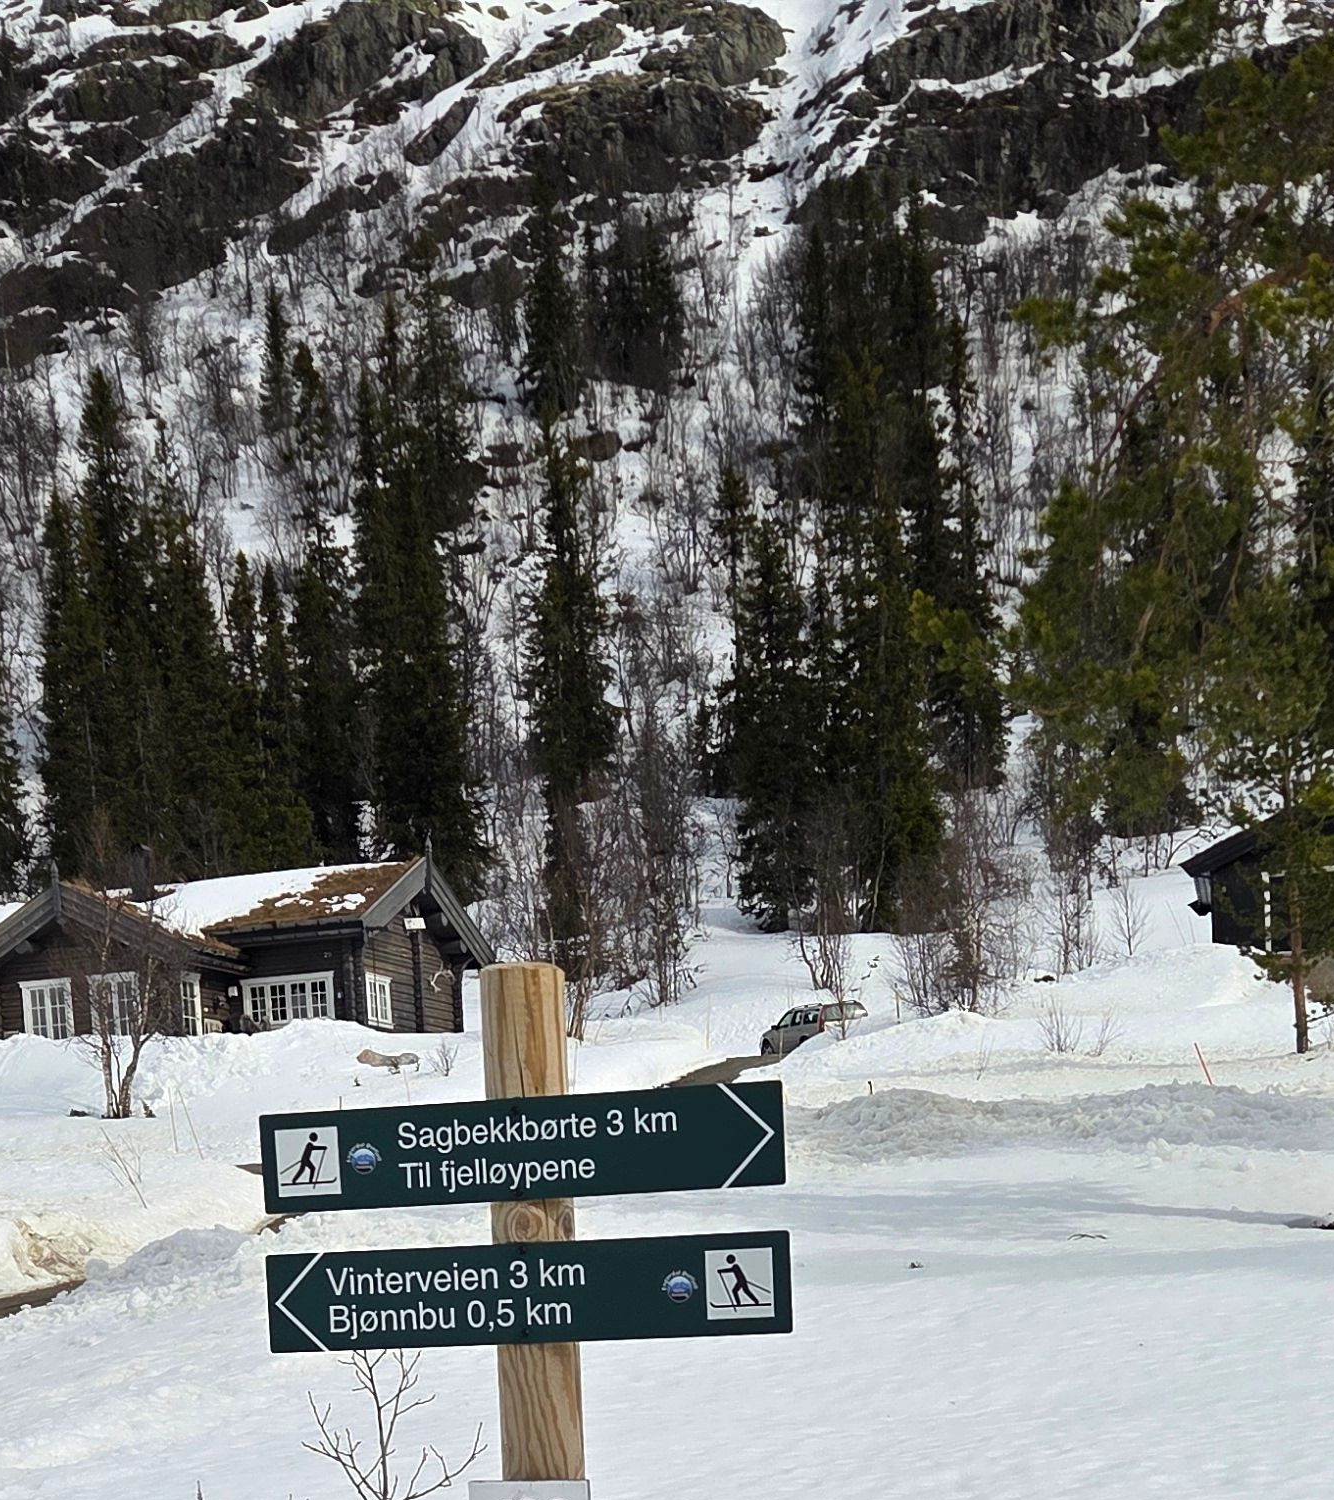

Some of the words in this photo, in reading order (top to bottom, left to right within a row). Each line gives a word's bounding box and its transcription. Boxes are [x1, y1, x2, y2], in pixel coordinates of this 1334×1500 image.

[397, 1113, 597, 1154] Sagbekkbørte
[606, 1109, 624, 1136] 3
[634, 1107, 678, 1134] km
[398, 1160, 431, 1189] Til
[439, 1157, 596, 1193] fjelløypene
[325, 1262, 499, 1296] Vinterveien
[509, 1260, 528, 1289] 3
[539, 1258, 586, 1287] km
[329, 1301, 456, 1340] Bjønnbu
[467, 1298, 515, 1332] 0,5
[526, 1297, 572, 1325] km
